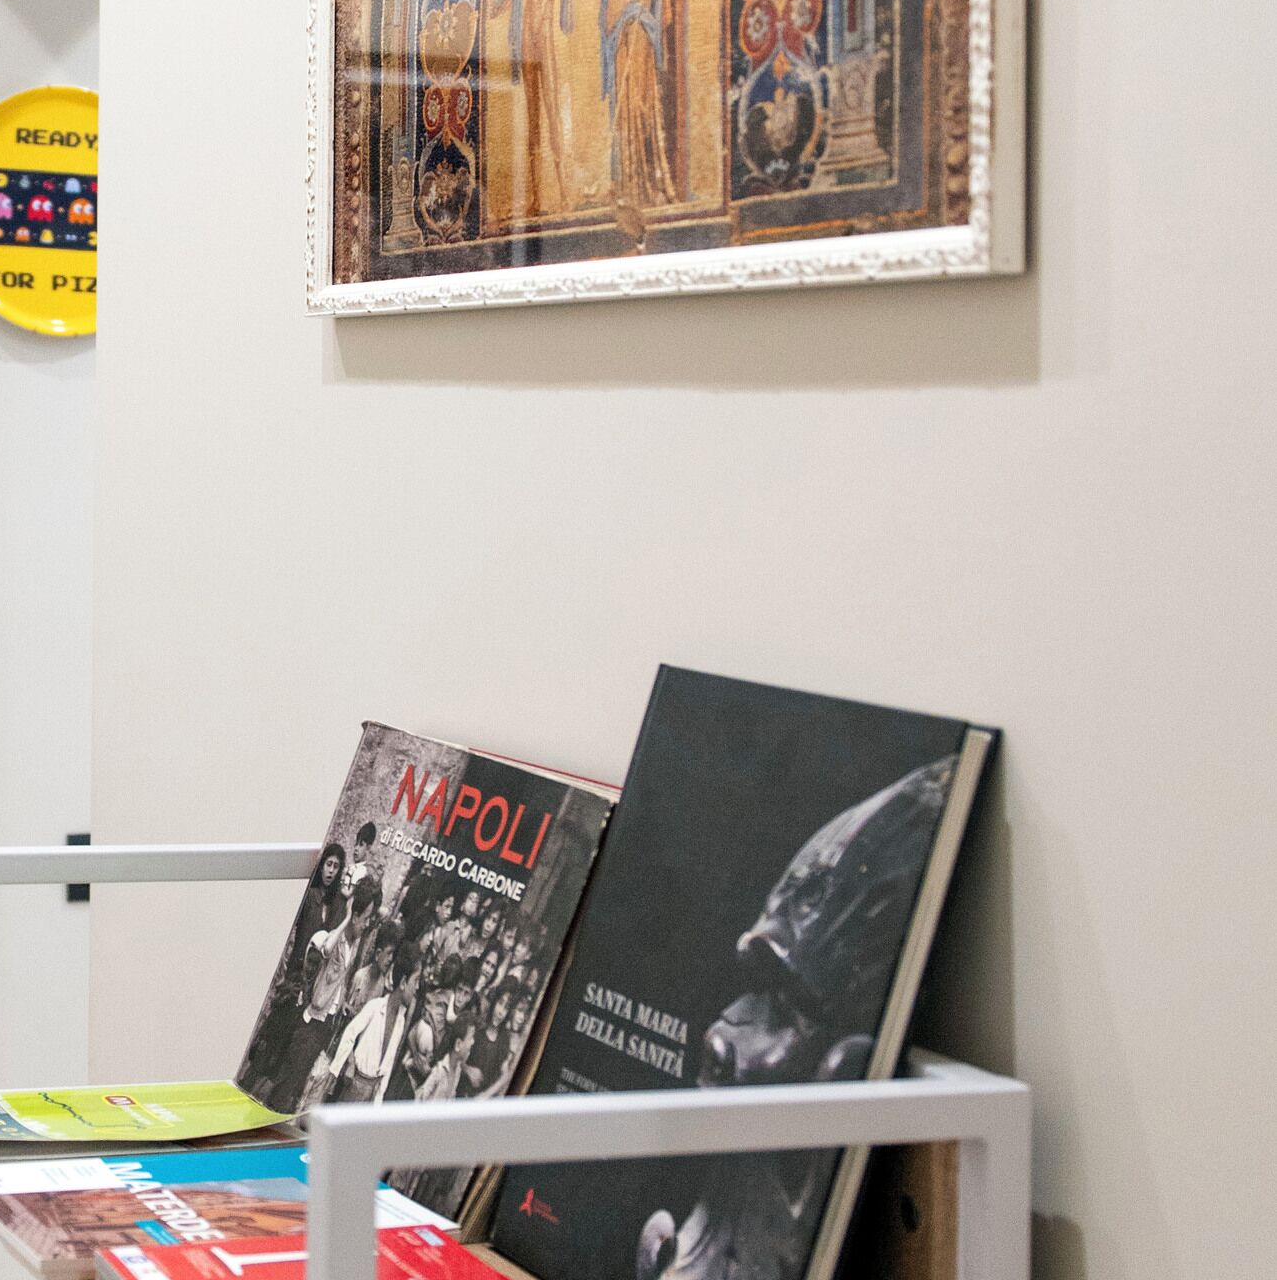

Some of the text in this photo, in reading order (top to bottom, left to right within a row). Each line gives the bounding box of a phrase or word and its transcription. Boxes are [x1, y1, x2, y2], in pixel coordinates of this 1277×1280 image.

[16, 128, 98, 149] READY
[390, 763, 553, 869] NAPOLI
[380, 828, 526, 902] di RICCARDO CARBONE
[575, 1011, 685, 1078] DELLA SANITÀ
[584, 982, 688, 1045] SANTA MARIA
